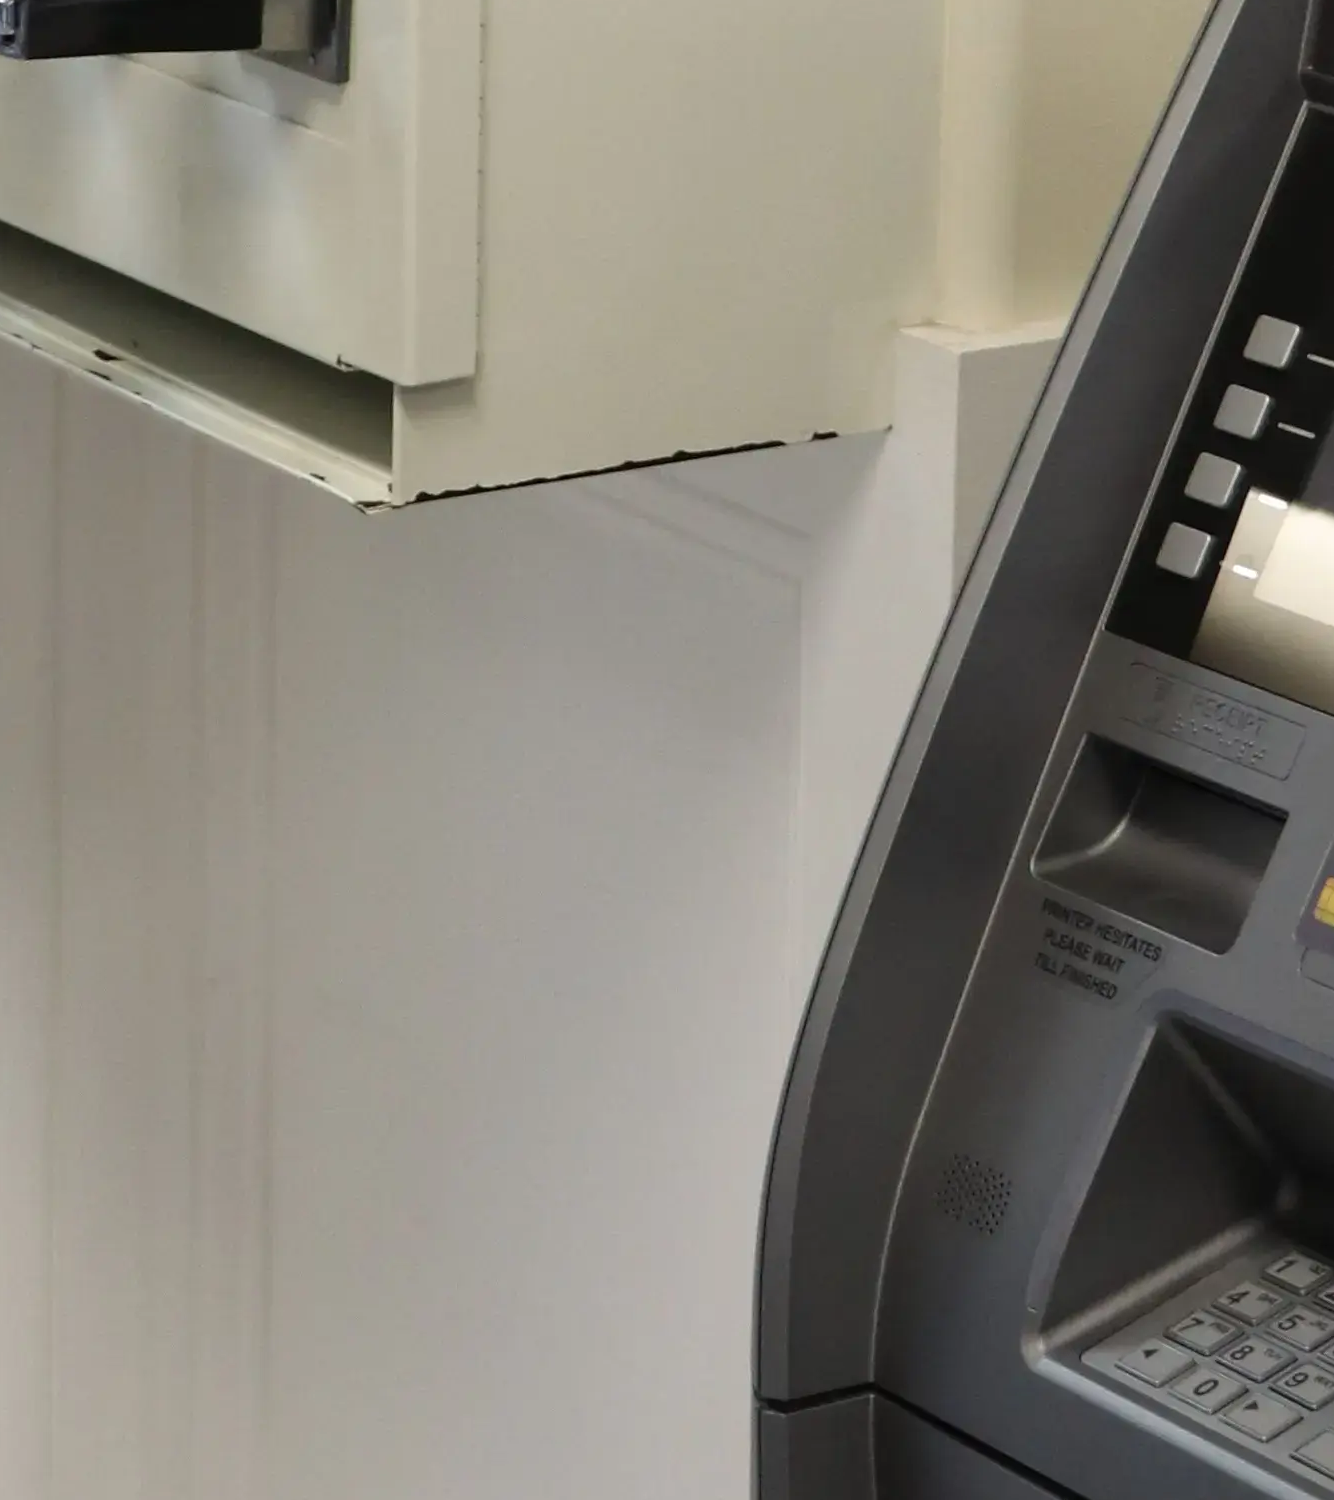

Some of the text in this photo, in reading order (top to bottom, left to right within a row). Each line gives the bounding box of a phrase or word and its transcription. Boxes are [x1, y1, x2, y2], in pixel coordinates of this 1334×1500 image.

[1095, 923, 1163, 962] HESITATES
[1274, 1258, 1295, 1275] 1
[1227, 1288, 1251, 1305] 4
[1179, 1317, 1205, 1334] 7
[1276, 1313, 1302, 1331] 5
[1230, 1344, 1255, 1361] 8
[1192, 1378, 1220, 1397] 0
[1284, 1371, 1309, 1389] 9
